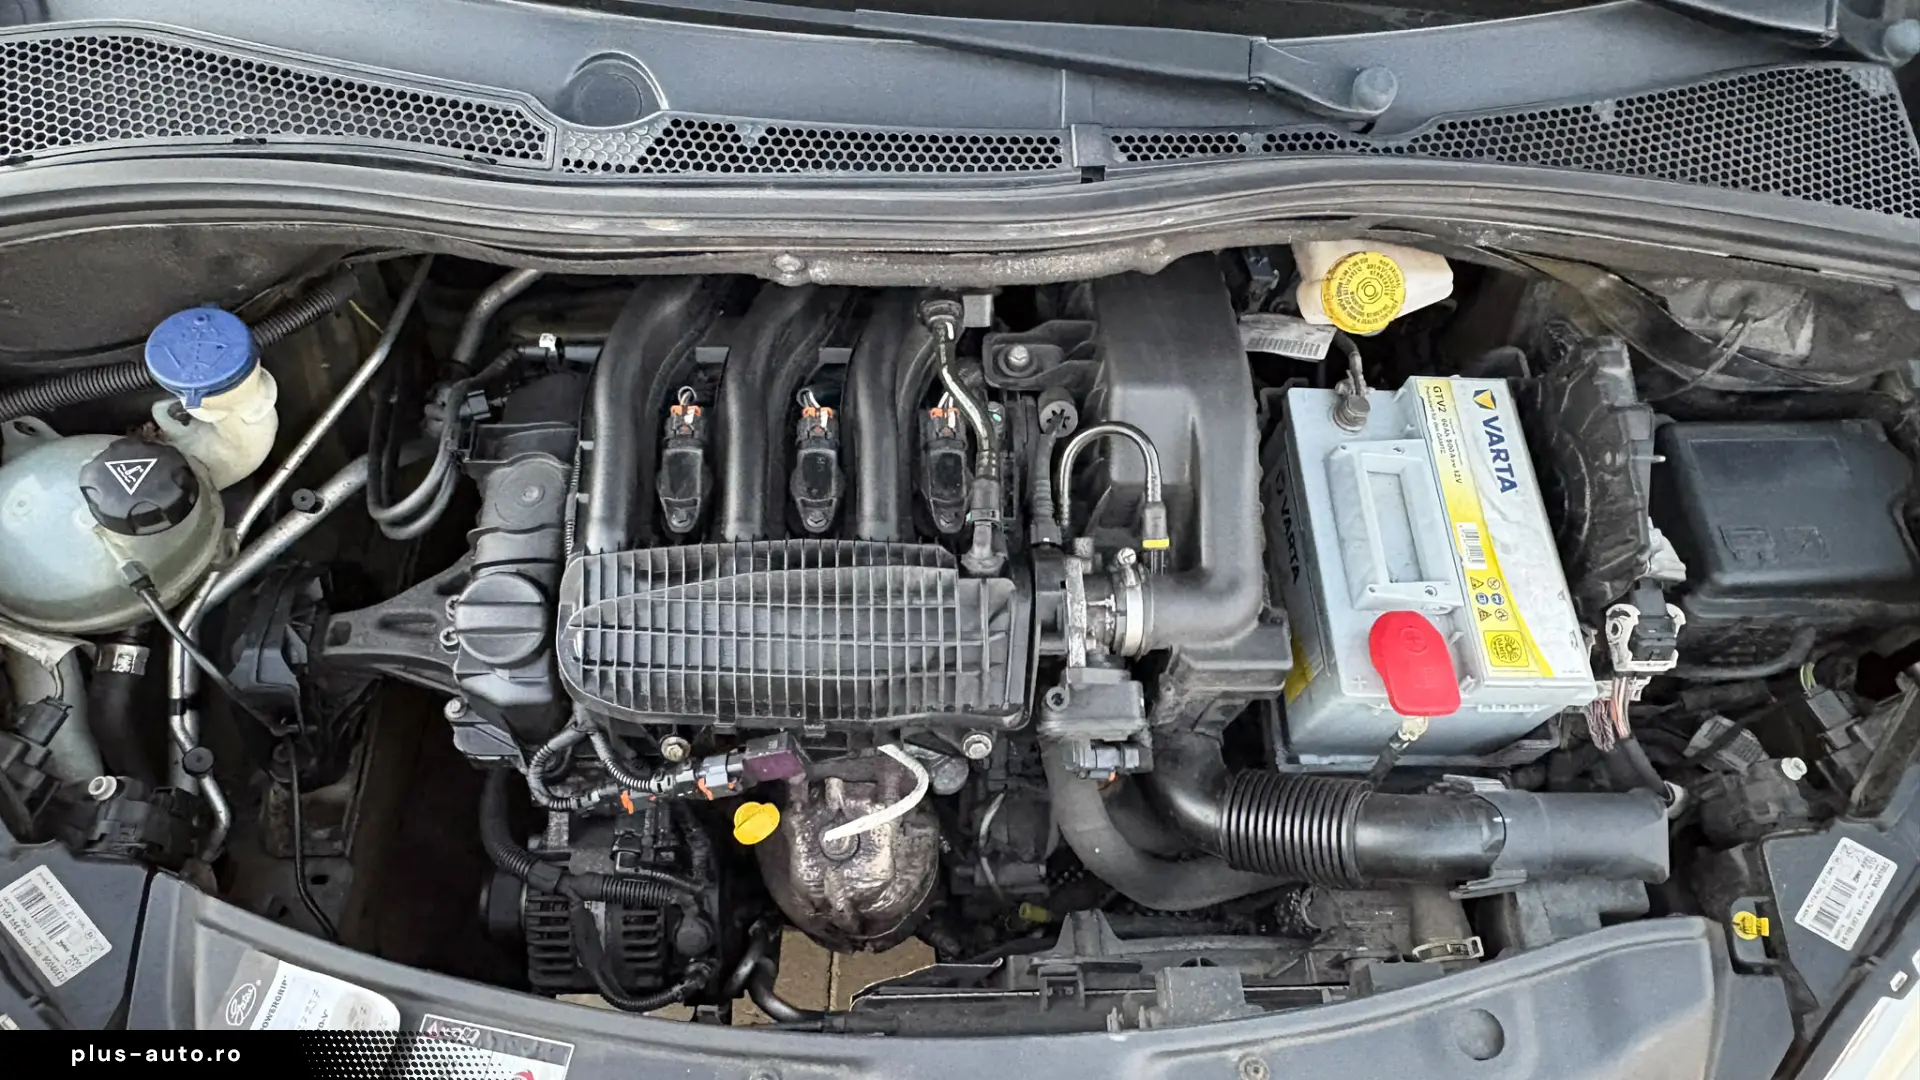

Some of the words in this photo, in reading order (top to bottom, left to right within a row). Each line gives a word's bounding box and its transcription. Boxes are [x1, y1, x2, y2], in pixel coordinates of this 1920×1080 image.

[1432, 385, 1447, 413] GTV2
[1482, 415, 1518, 494] VARTA
[1282, 496, 1300, 584] VARTA
[260, 979, 288, 1030] OWERGRIP
